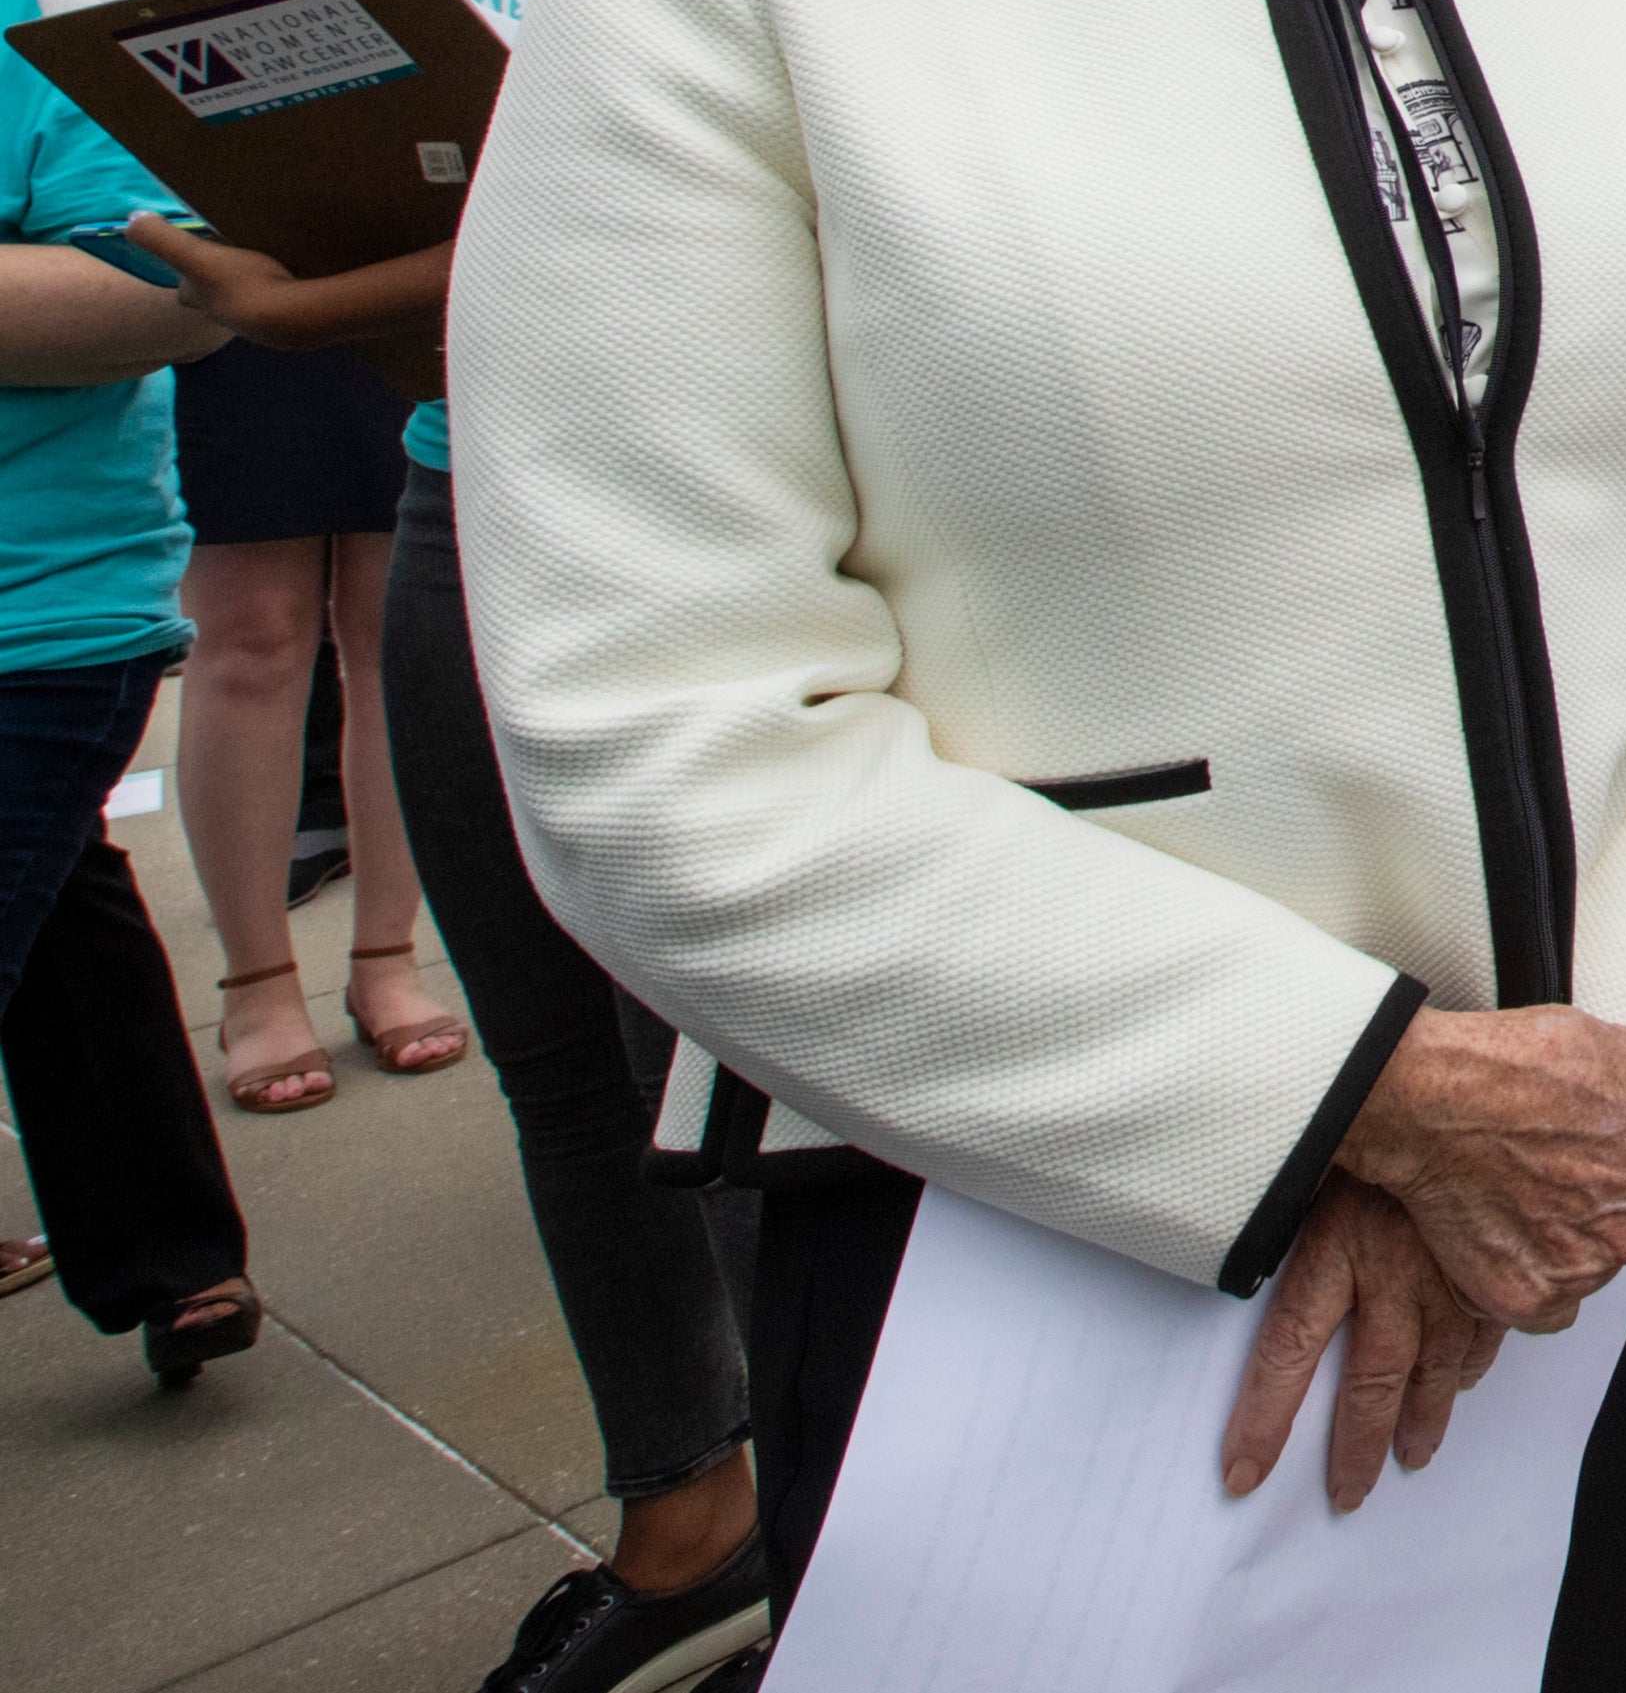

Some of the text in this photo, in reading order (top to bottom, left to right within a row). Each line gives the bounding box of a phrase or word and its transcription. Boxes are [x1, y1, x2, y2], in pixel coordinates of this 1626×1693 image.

[212, 0, 358, 47] NATIONAL
[228, 16, 373, 62] WOMEN'S
[188, 48, 399, 107] EXPANDING THE POSSIBILITIES
[249, 33, 389, 79] LAW CENTER
